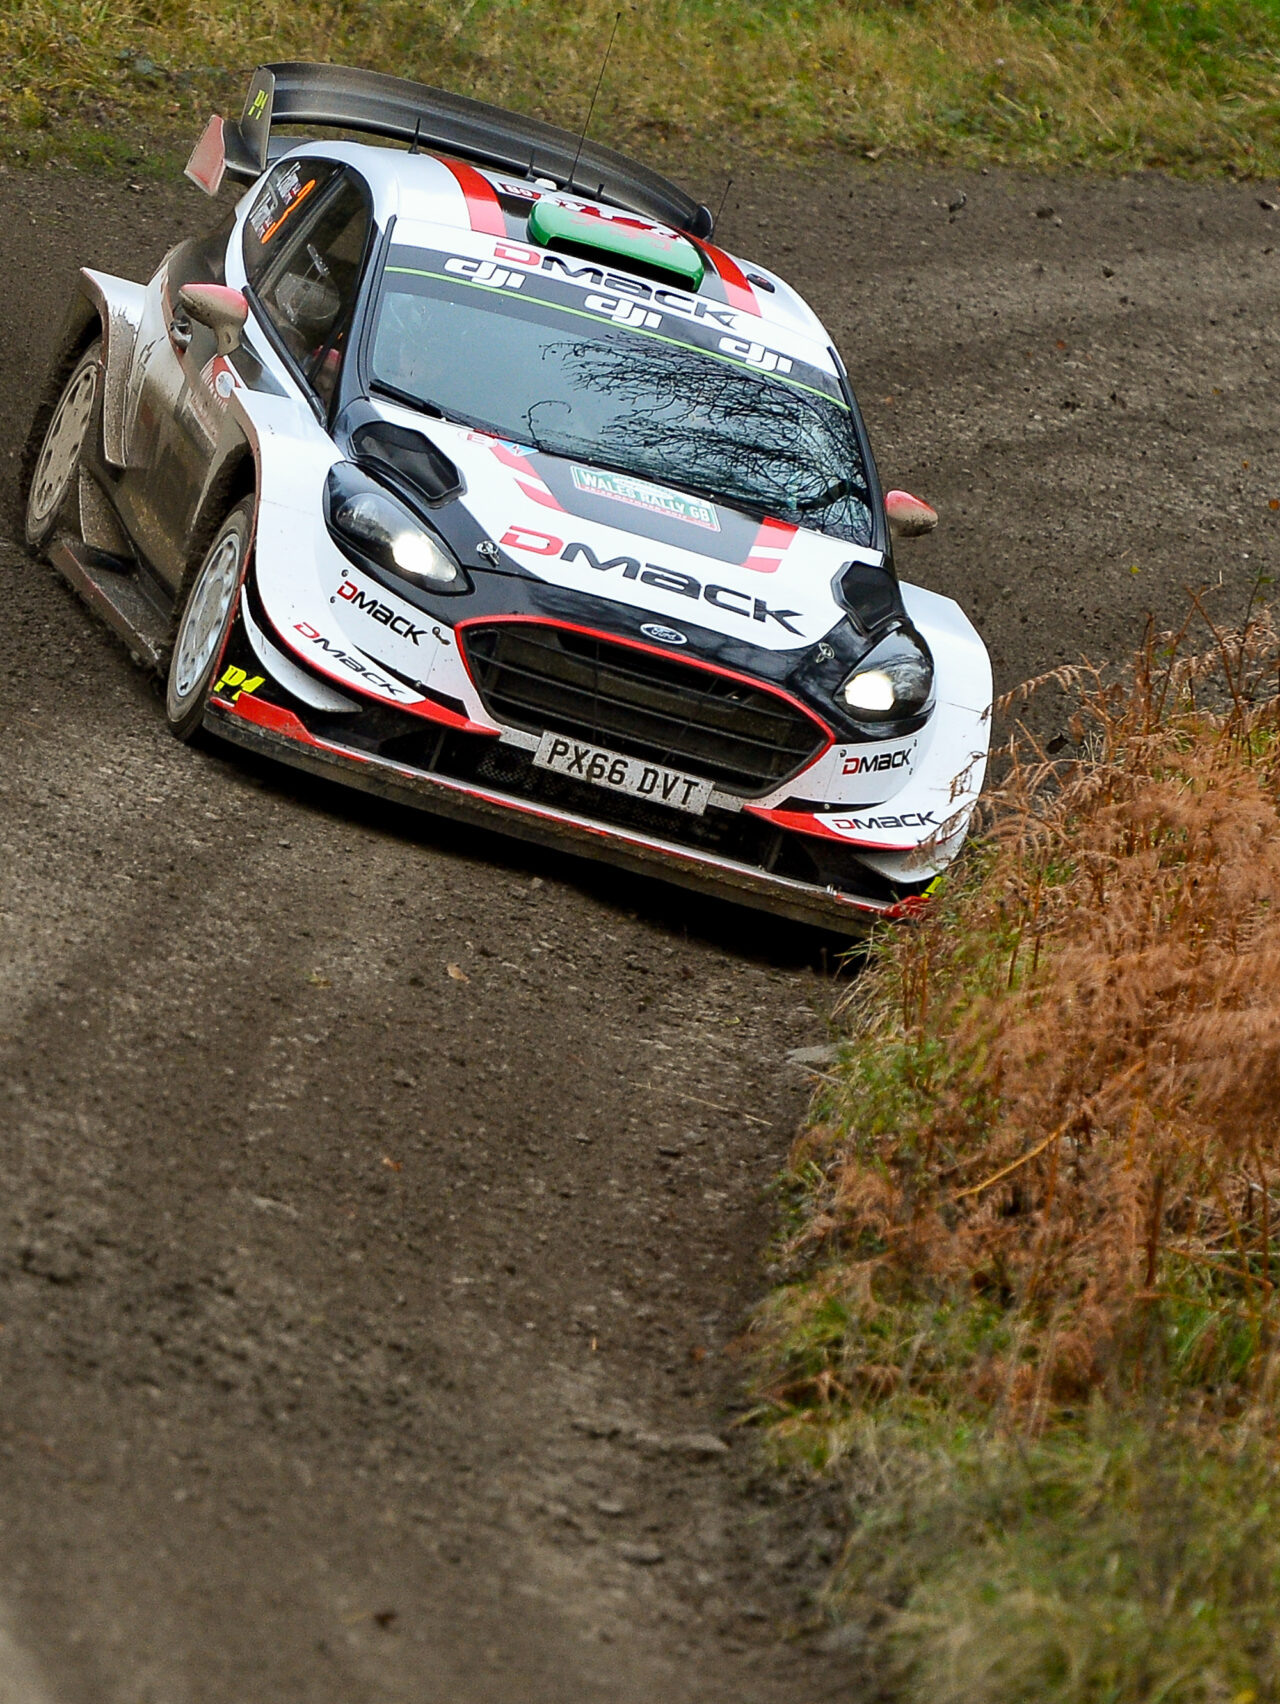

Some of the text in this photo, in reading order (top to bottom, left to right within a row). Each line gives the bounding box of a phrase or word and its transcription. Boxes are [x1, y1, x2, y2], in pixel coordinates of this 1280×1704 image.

[580, 471, 637, 498] WALES
[639, 491, 686, 513] RALLY
[689, 505, 711, 522] GB
[547, 738, 700, 805] PX66 DVT
